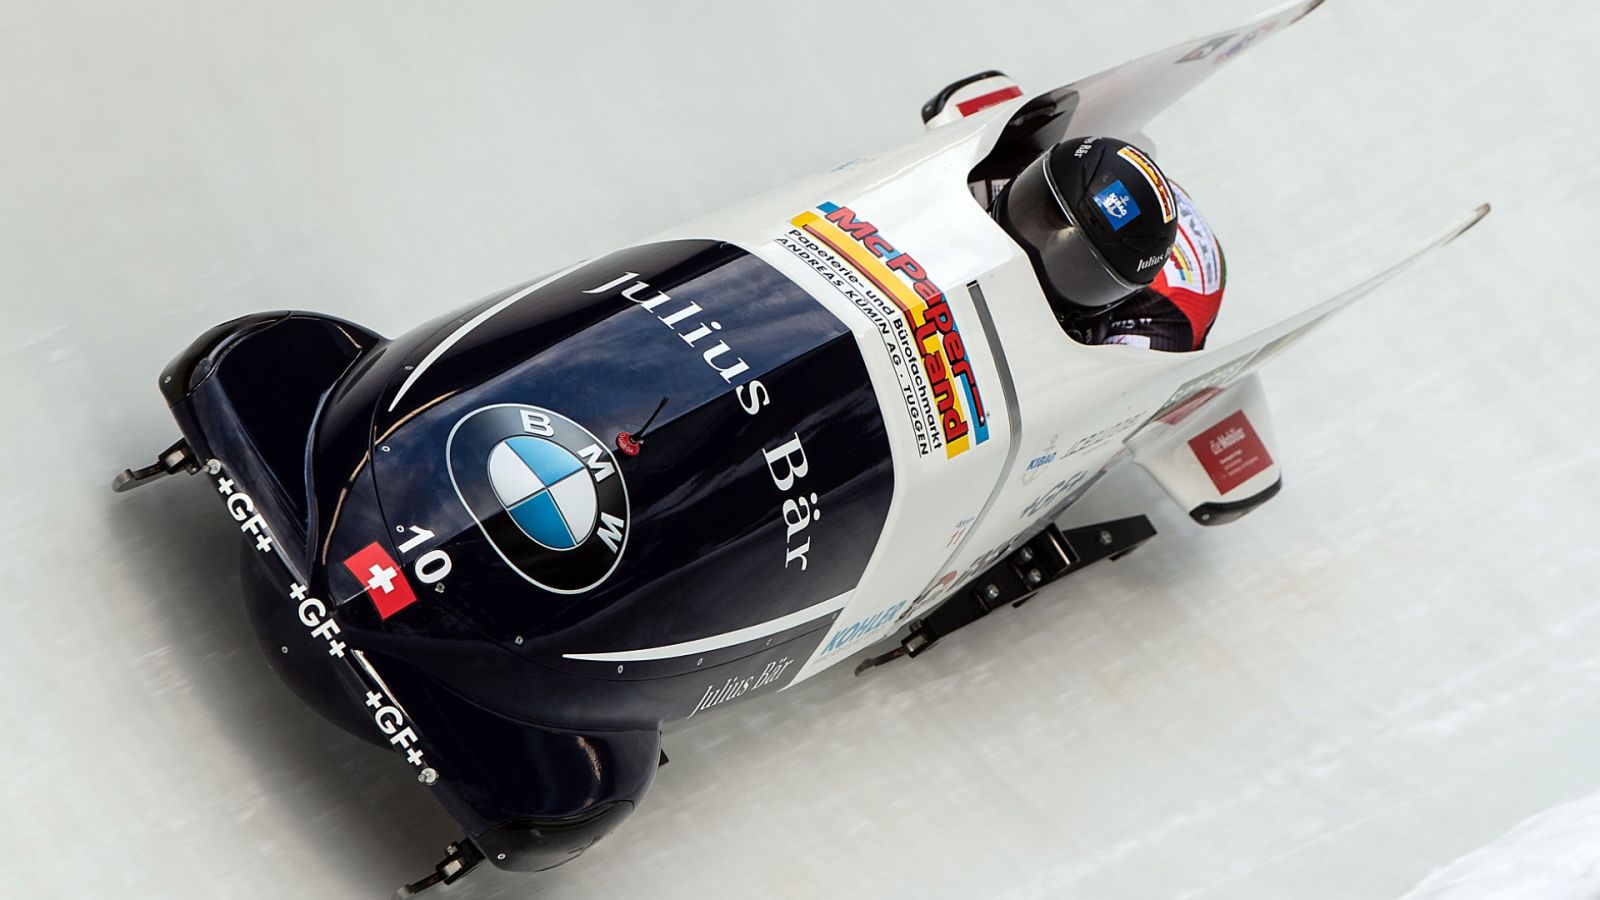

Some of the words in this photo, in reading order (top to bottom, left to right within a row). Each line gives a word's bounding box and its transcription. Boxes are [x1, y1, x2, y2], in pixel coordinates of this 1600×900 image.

[1109, 192, 1128, 216] KIBAG
[1136, 253, 1164, 272] Julius
[776, 238, 844, 286] ANDREAS
[845, 290, 890, 335] KÜMIN
[887, 342, 901, 366] AG
[903, 385, 928, 456] TUGGEN
[788, 229, 864, 288] Papeterie-
[866, 290, 895, 316] und
[893, 318, 942, 449] Bürofachmarkt
[914, 321, 969, 444] Land
[582, 271, 770, 416] Julius
[762, 431, 821, 571] Bär
[398, 524, 452, 584] 10
[820, 599, 907, 656] KOHLER
[686, 676, 755, 720] Julius
[751, 656, 794, 691] Bär
